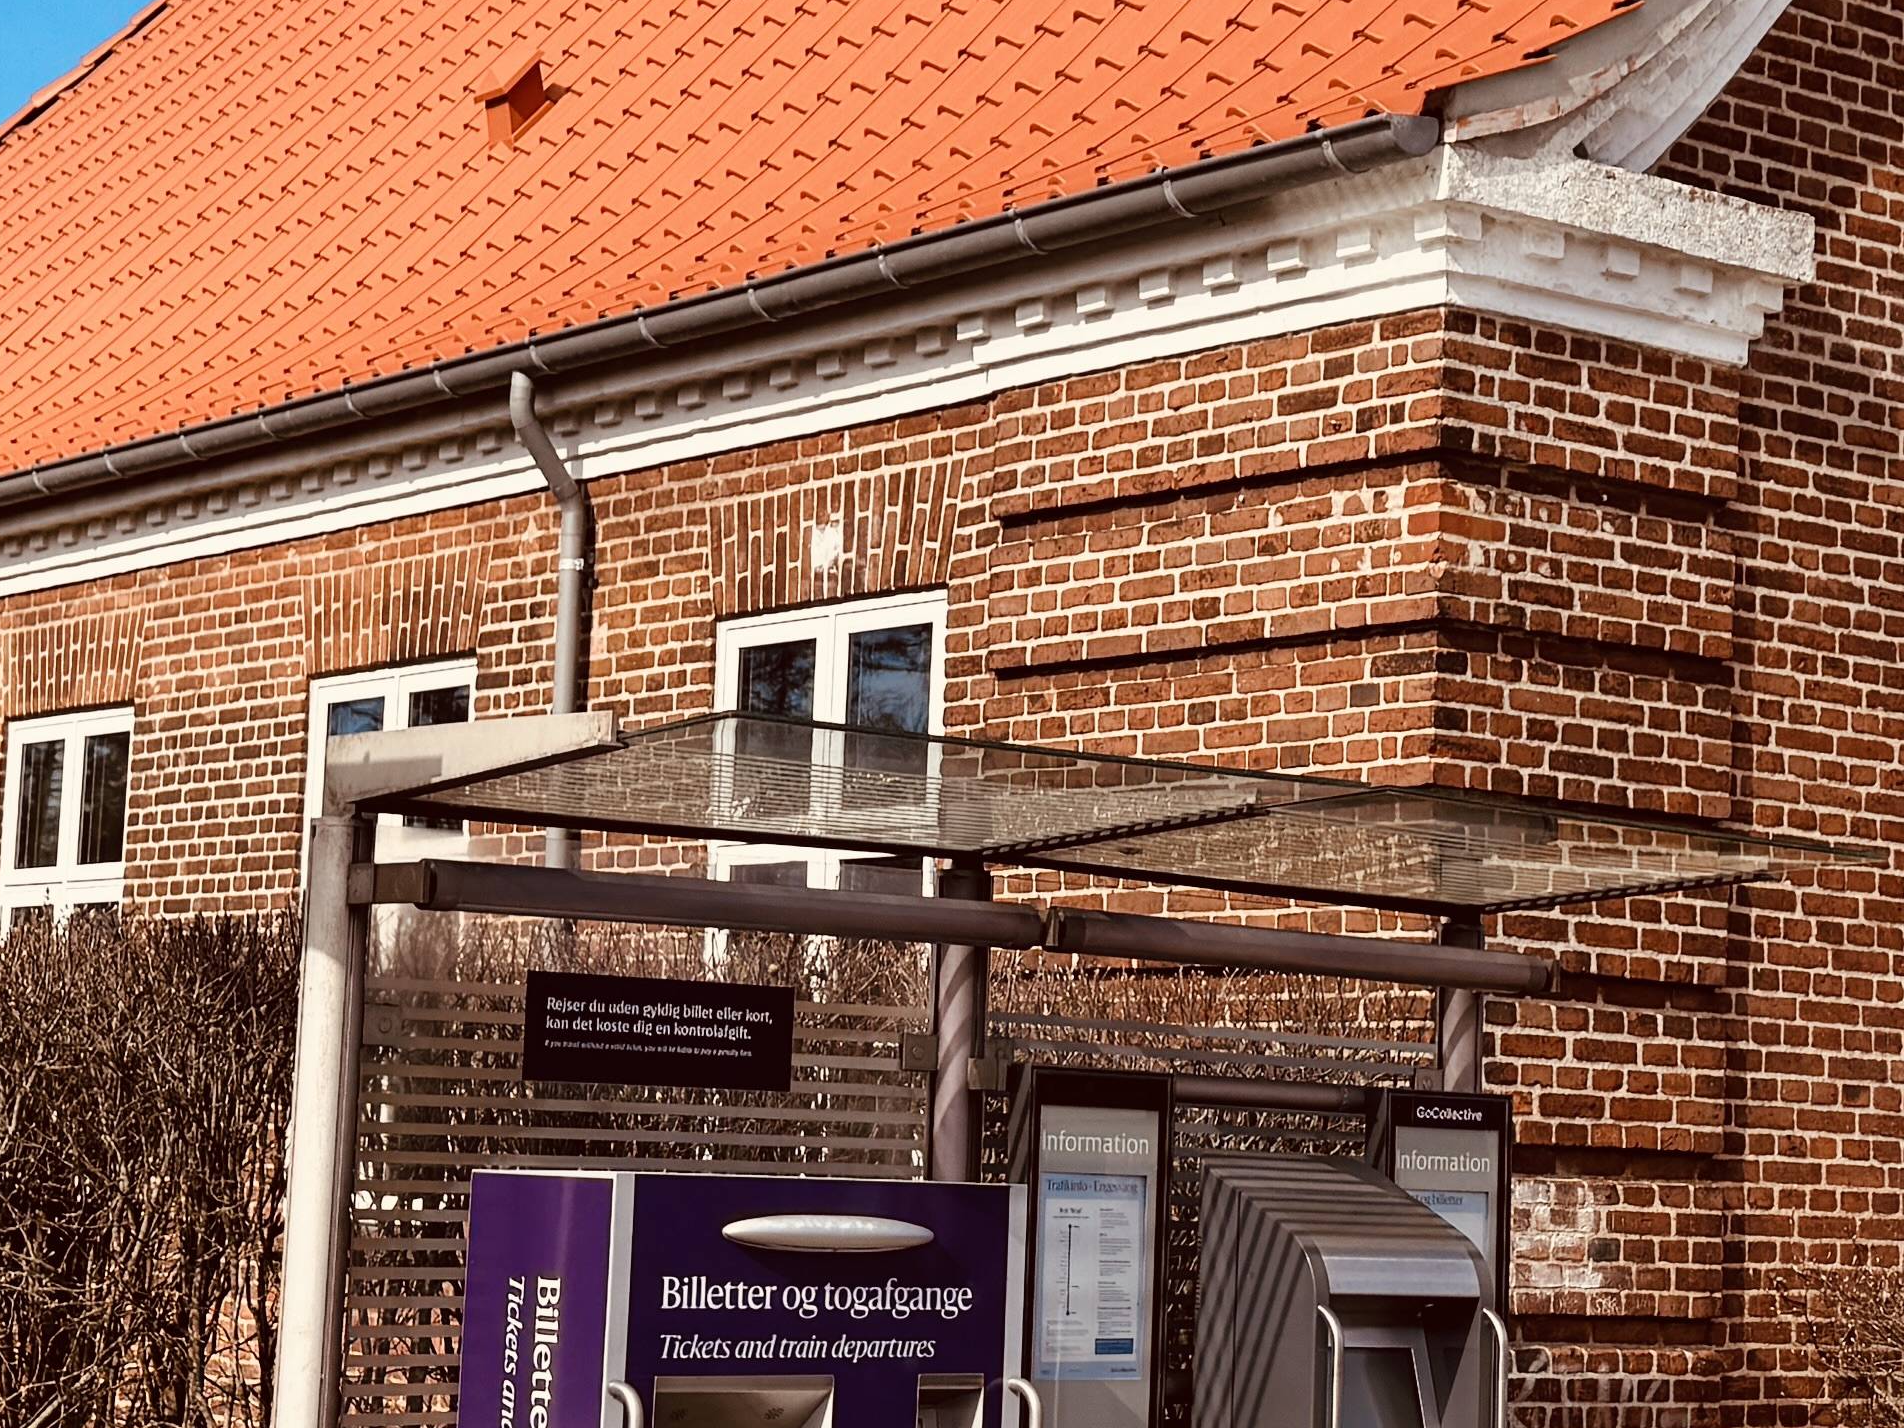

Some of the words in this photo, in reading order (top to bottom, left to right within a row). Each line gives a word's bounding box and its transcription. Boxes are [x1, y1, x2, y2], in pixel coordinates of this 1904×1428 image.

[547, 997, 586, 1014] Rejser
[589, 999, 605, 1012] du
[609, 1000, 639, 1015] uden
[643, 1002, 680, 1019] gyldig
[683, 1004, 713, 1020] billet
[717, 1006, 743, 1021] eller
[746, 1008, 773, 1025] kort,
[546, 1015, 569, 1029] kan
[572, 1016, 593, 1031] det
[596, 1017, 630, 1033] koste
[633, 1019, 653, 1036] dig
[656, 1024, 671, 1035] en
[674, 1022, 751, 1041] kontrolafgift.
[1416, 1106, 1483, 1122] GoCollective
[1042, 1130, 1149, 1155] Information
[1397, 1149, 1490, 1173] Information
[660, 1276, 777, 1310] Billetter
[782, 1285, 818, 1319] og
[824, 1278, 973, 1319] togafgange
[503, 1276, 526, 1376] Tickets
[660, 1334, 732, 1359] Tickets
[734, 1334, 777, 1359] and
[779, 1335, 827, 1359] train
[831, 1335, 936, 1363] departures
